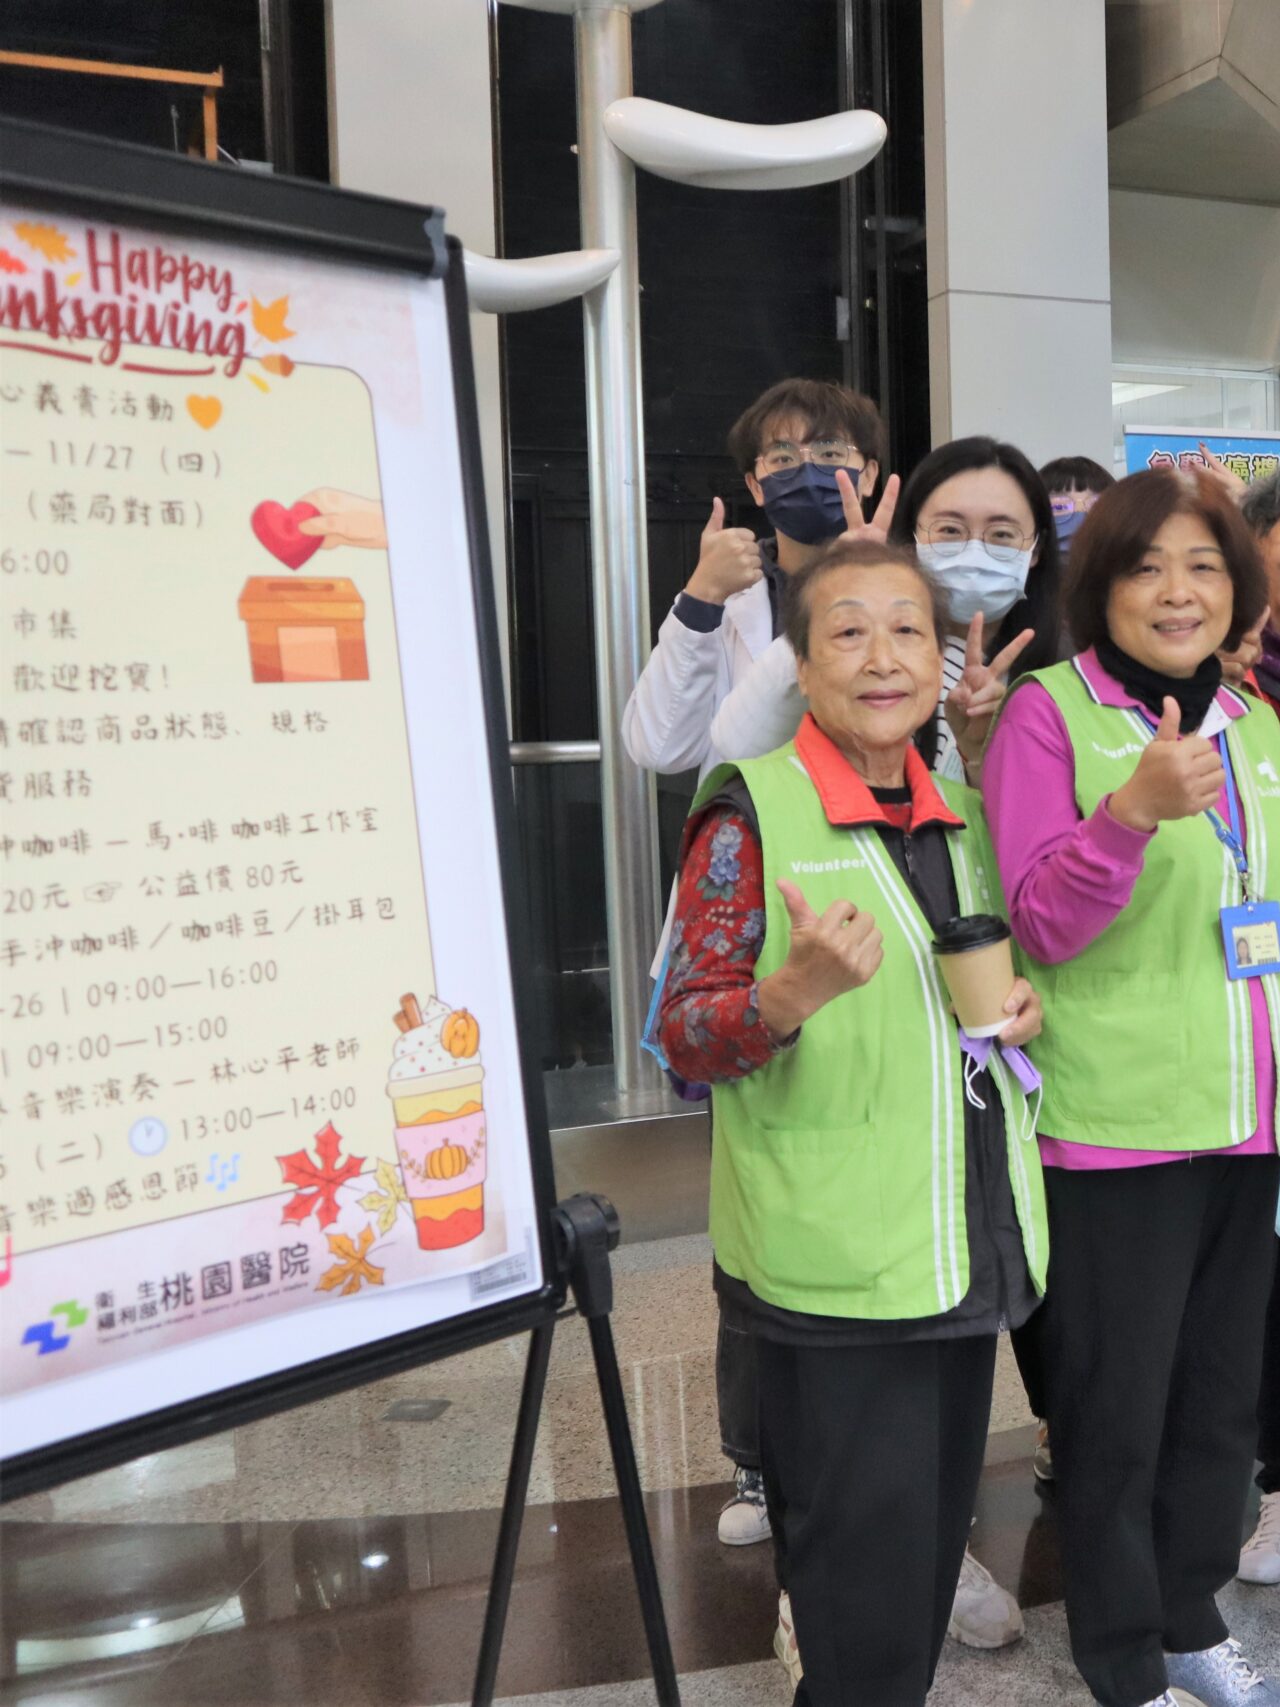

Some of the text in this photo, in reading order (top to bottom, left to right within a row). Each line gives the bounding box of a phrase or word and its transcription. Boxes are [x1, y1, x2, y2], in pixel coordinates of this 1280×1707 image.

[85, 227, 234, 313] Happy
[12, 607, 77, 640] 市集
[790, 858, 871, 874] Volunteer
[0, 1072, 160, 1121] 音樂演奏
[210, 1037, 361, 1085] 林心平老師
[160, 1242, 310, 1312] 桃園醫院
